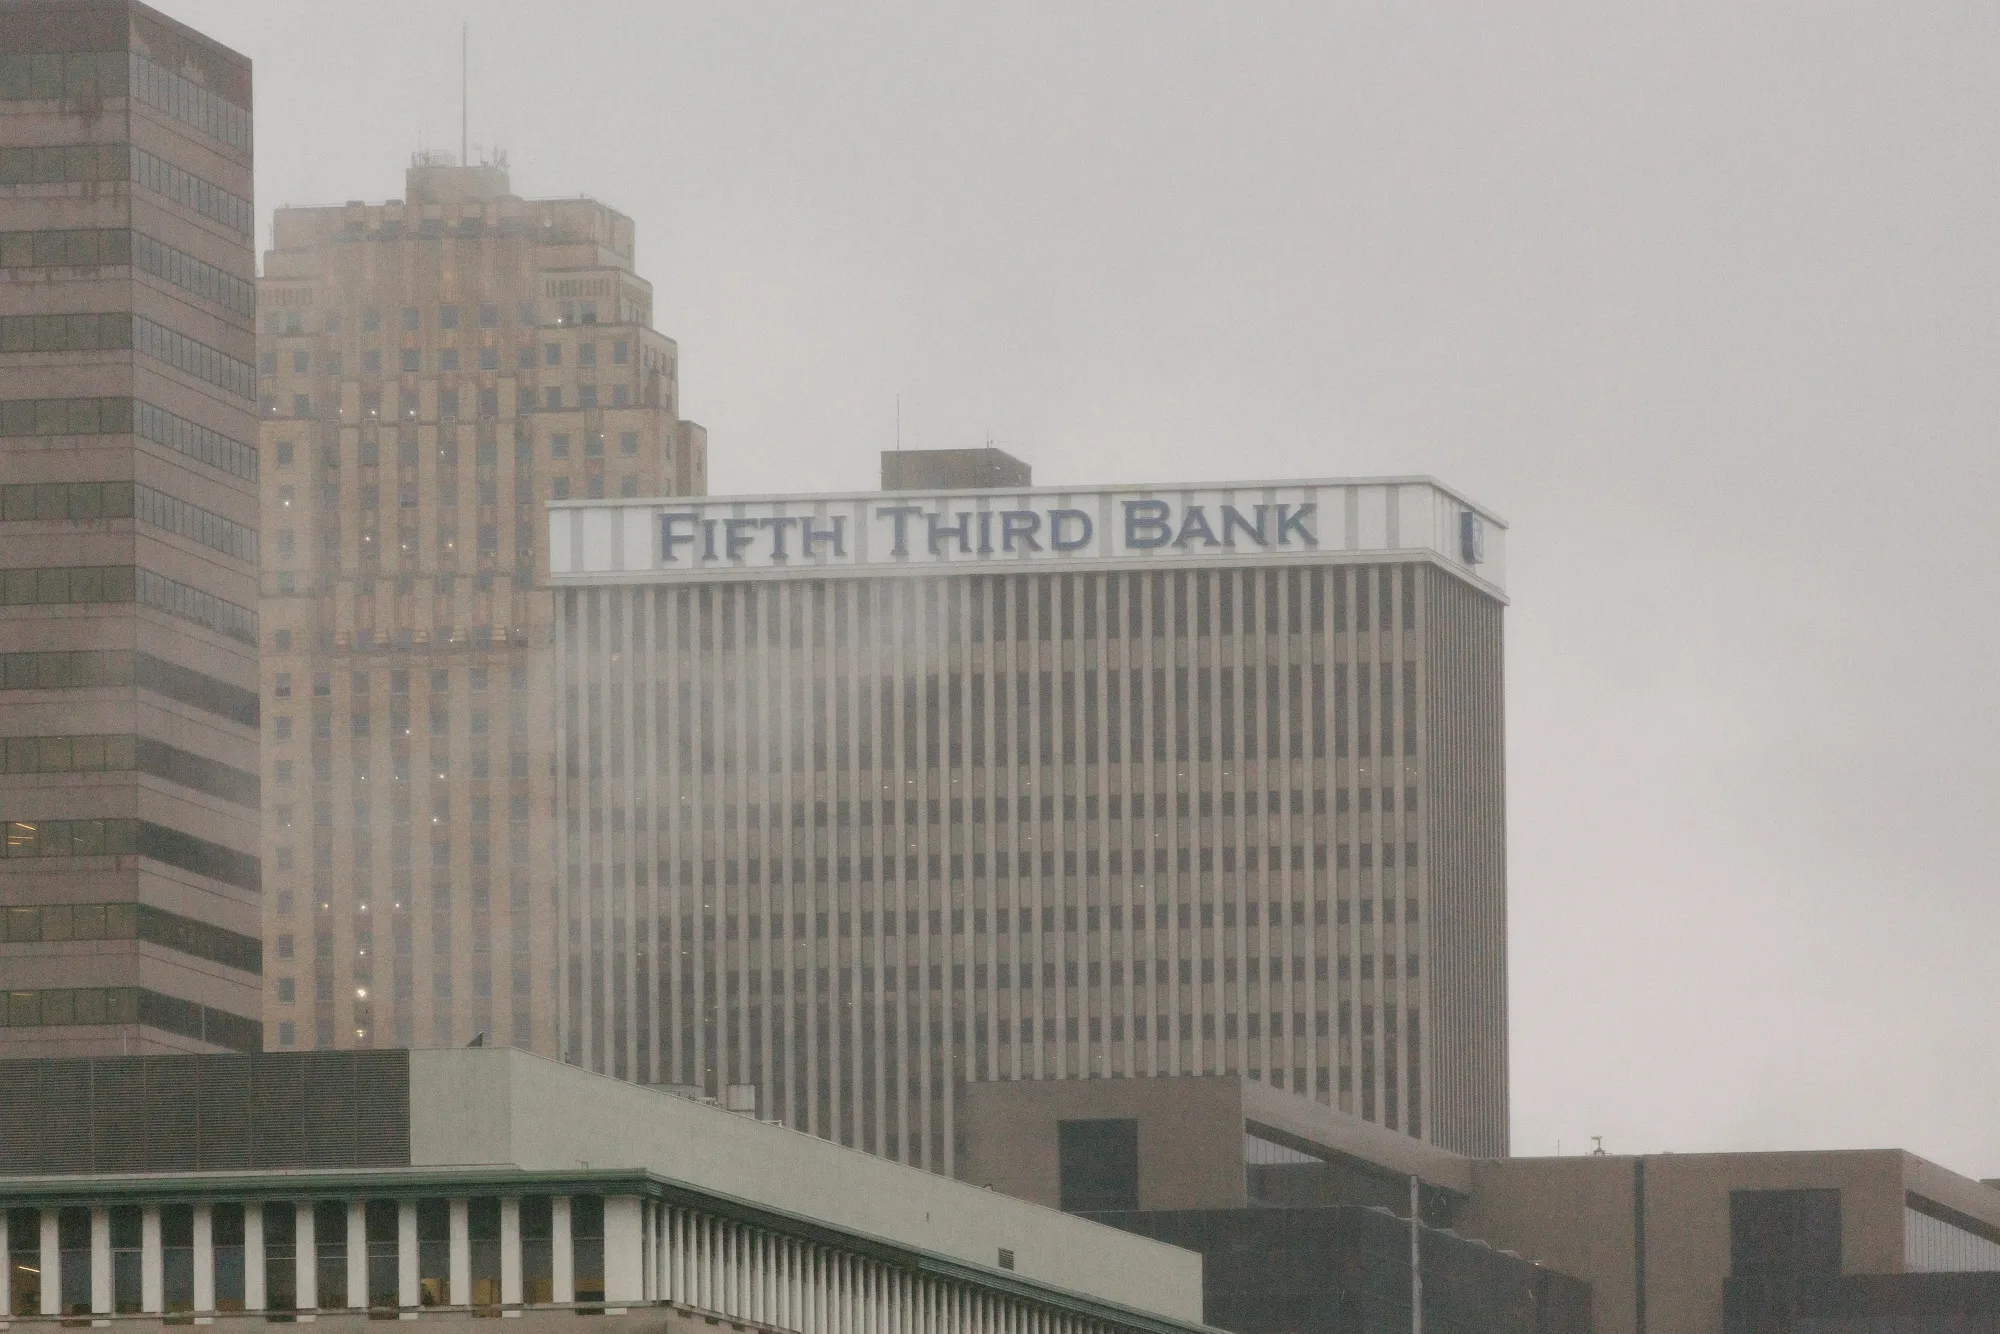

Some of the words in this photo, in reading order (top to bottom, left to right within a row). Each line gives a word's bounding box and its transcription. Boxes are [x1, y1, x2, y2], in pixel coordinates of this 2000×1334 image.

[658, 512, 847, 561] FIFTH
[876, 506, 1094, 556] THIRD
[1121, 500, 1319, 549] BANK
